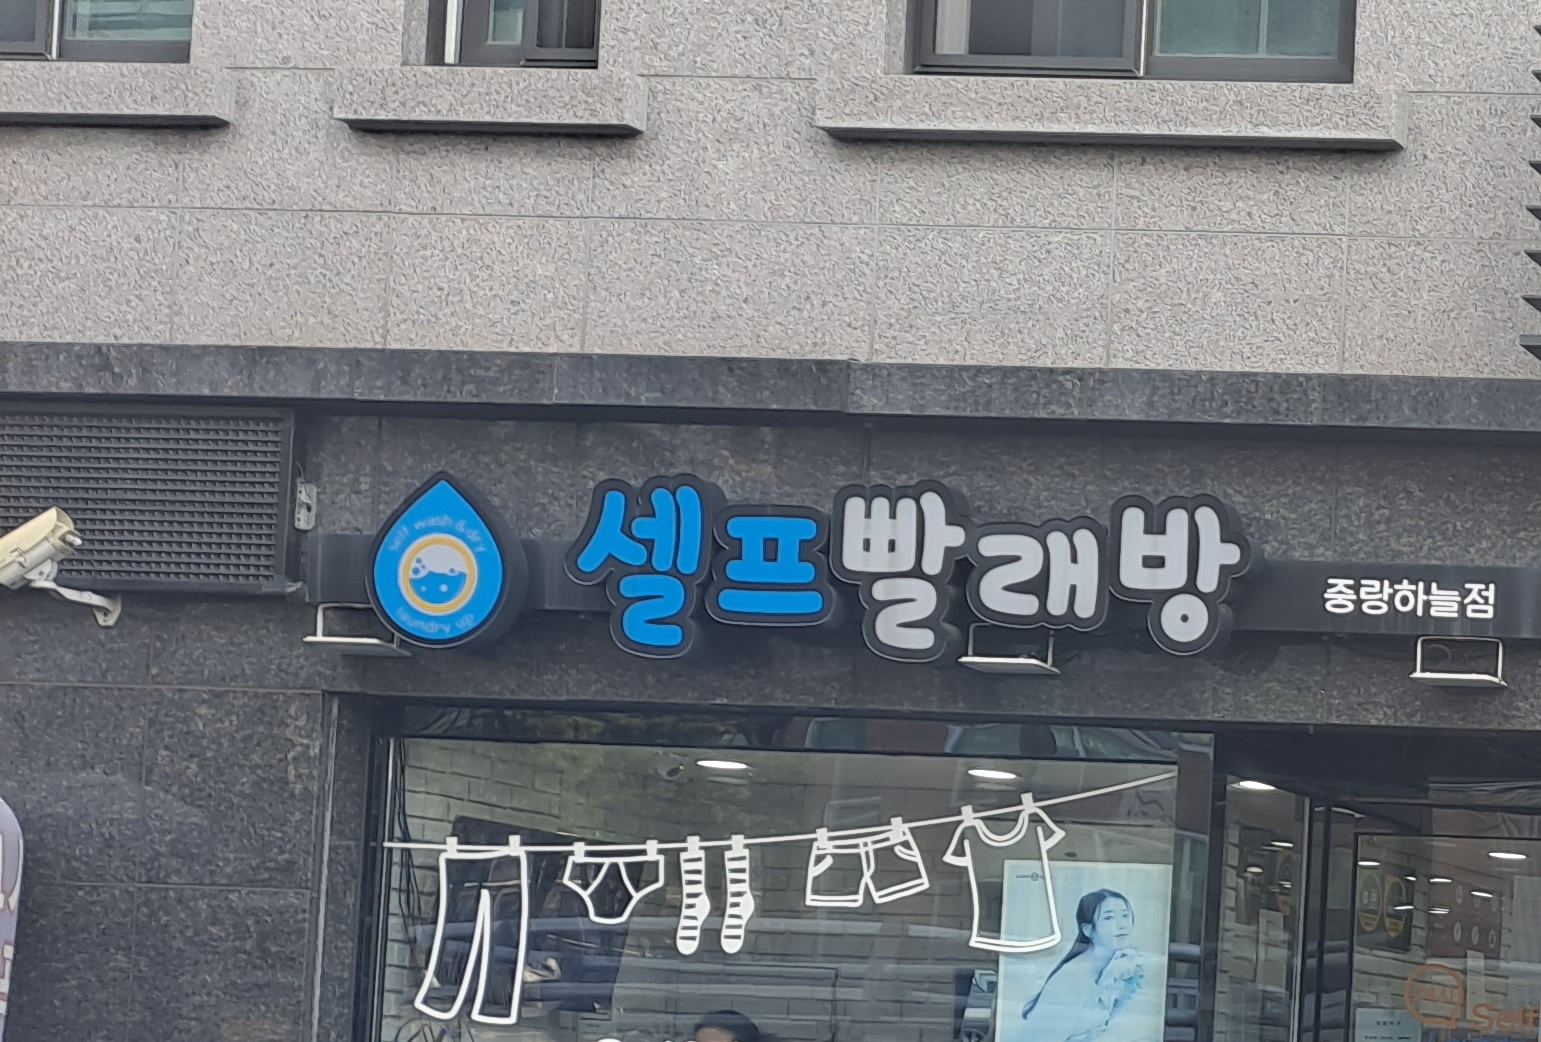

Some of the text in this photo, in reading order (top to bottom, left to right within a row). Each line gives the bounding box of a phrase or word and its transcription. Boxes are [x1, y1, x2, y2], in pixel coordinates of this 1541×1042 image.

[574, 481, 1244, 652] 셀프빨래방
[1321, 577, 1497, 619] 중랑하늘점
[1472, 1003, 1541, 1033] Self
